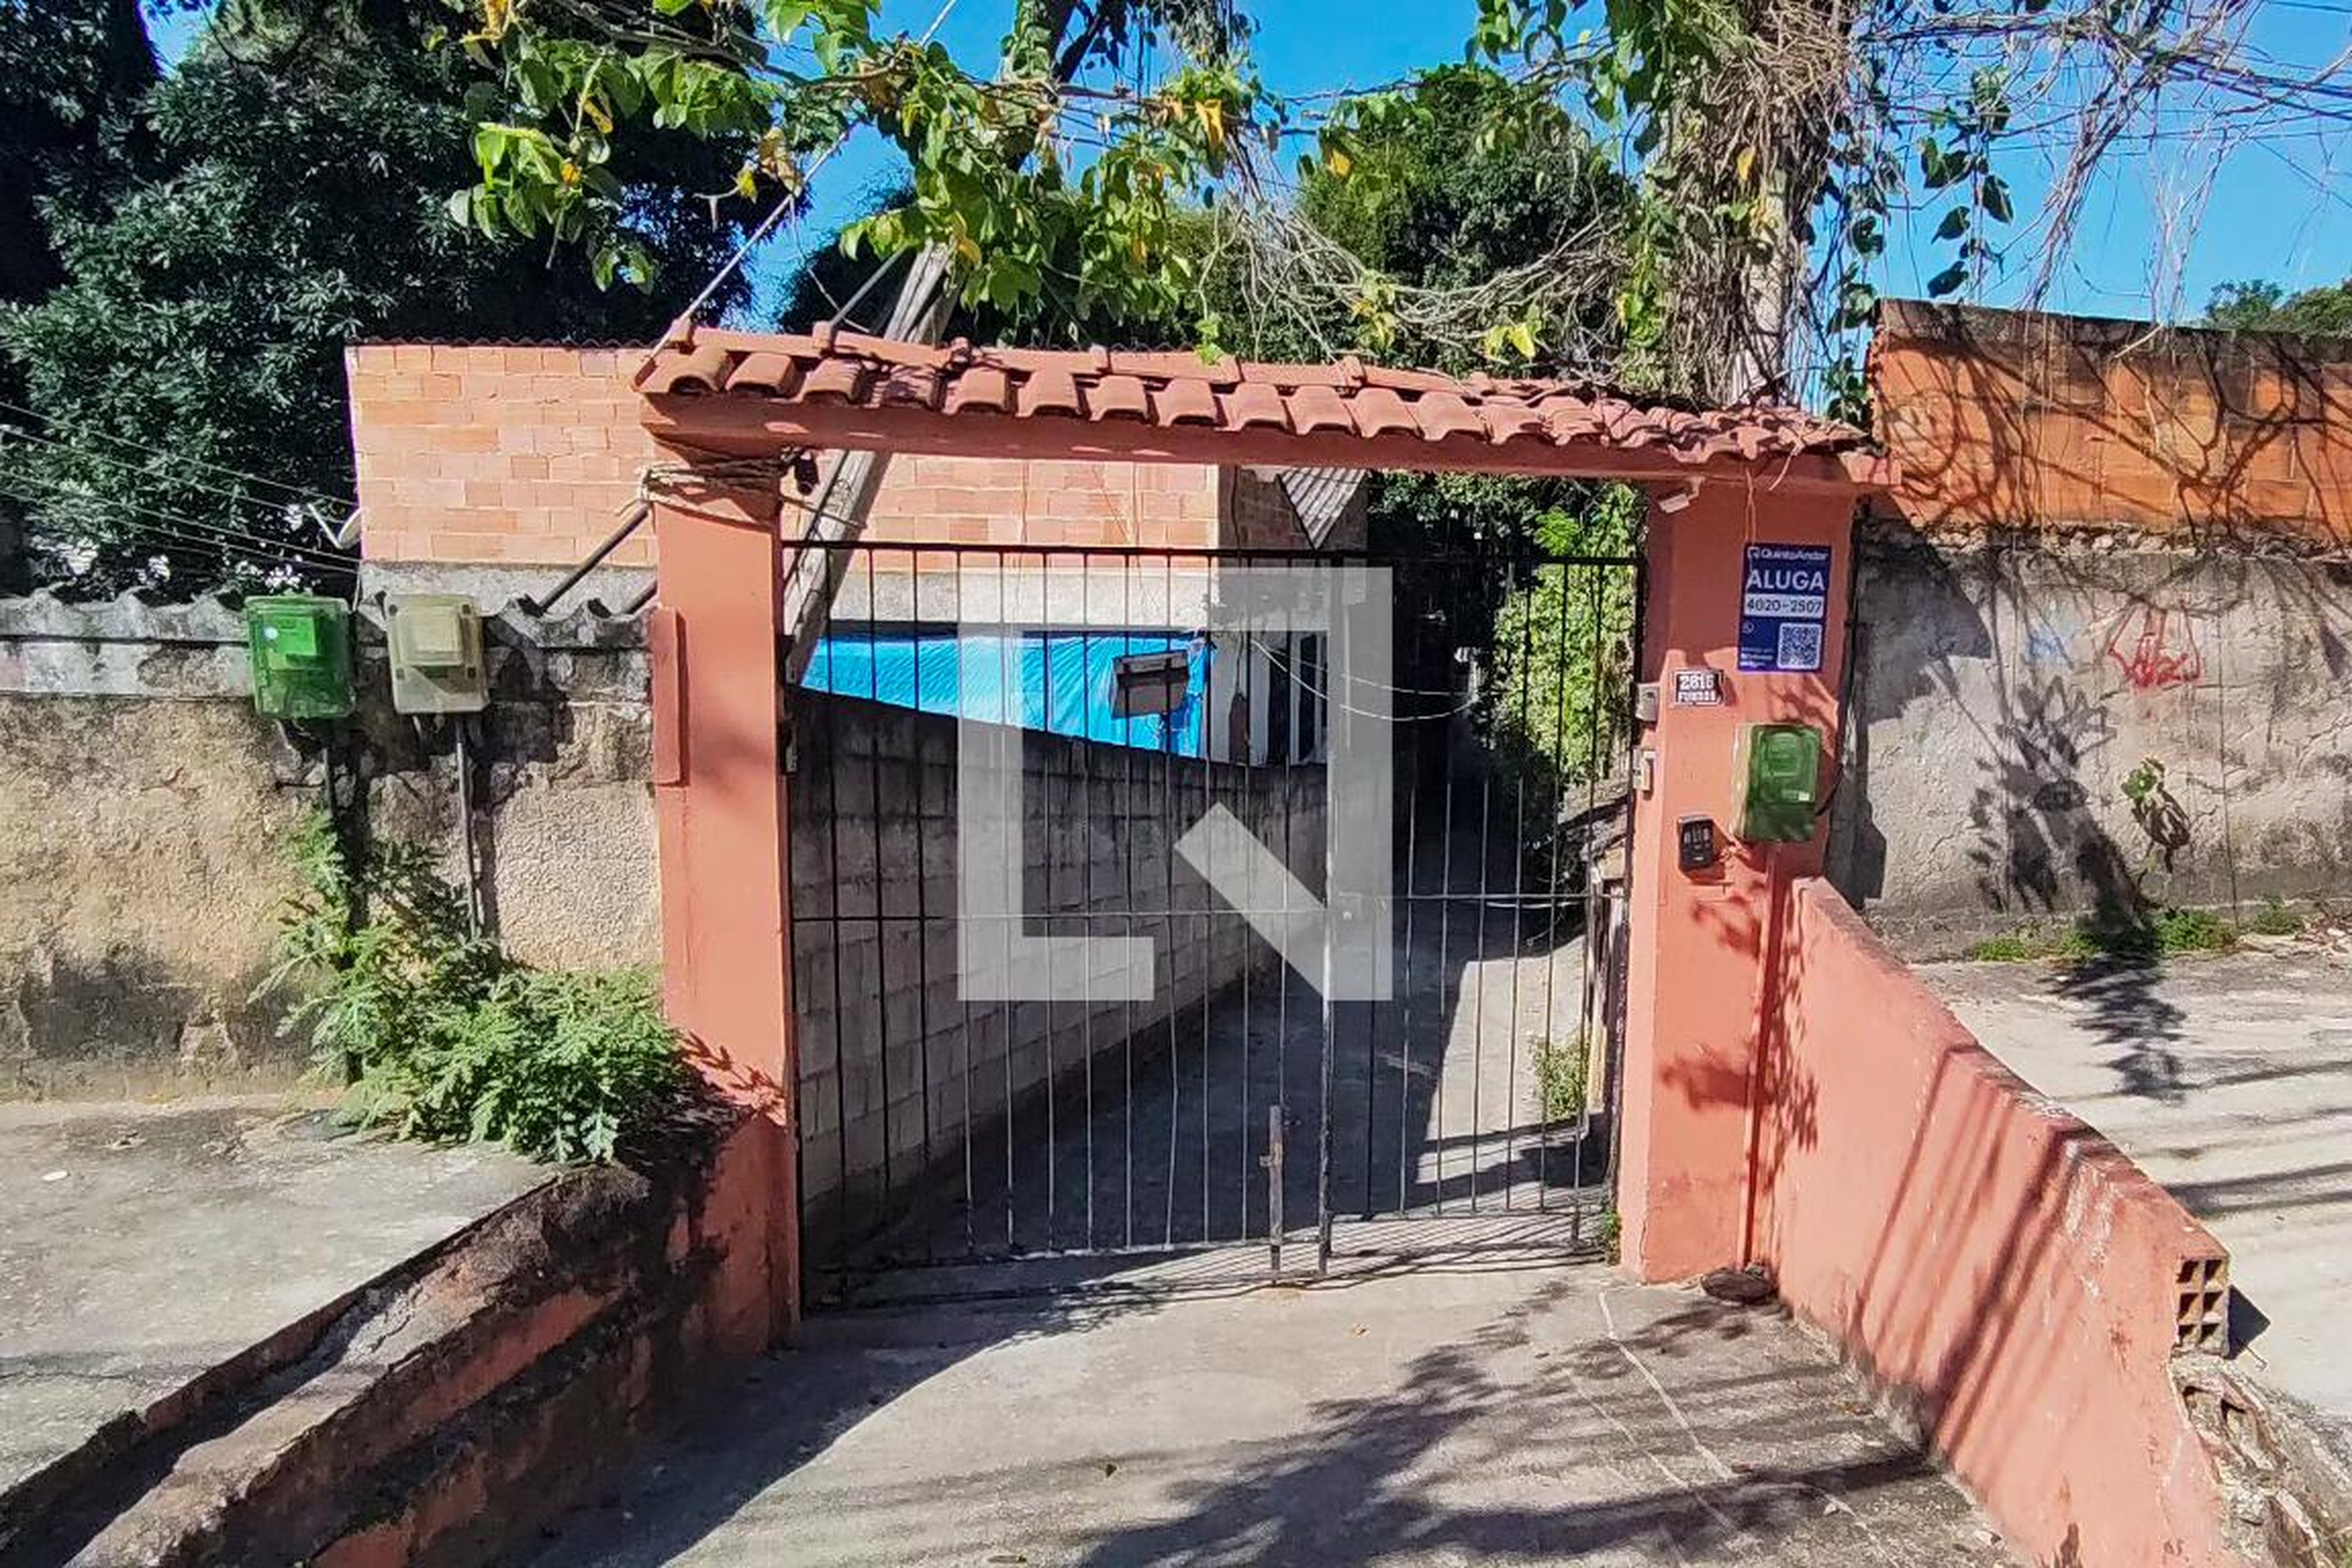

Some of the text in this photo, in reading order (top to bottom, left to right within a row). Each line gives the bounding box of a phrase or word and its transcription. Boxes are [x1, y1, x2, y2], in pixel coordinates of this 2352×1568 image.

[1761, 549, 1828, 560] QuintoAndar
[1746, 570, 1825, 590] ALUGA
[1747, 598, 1822, 613] 4020-2507
